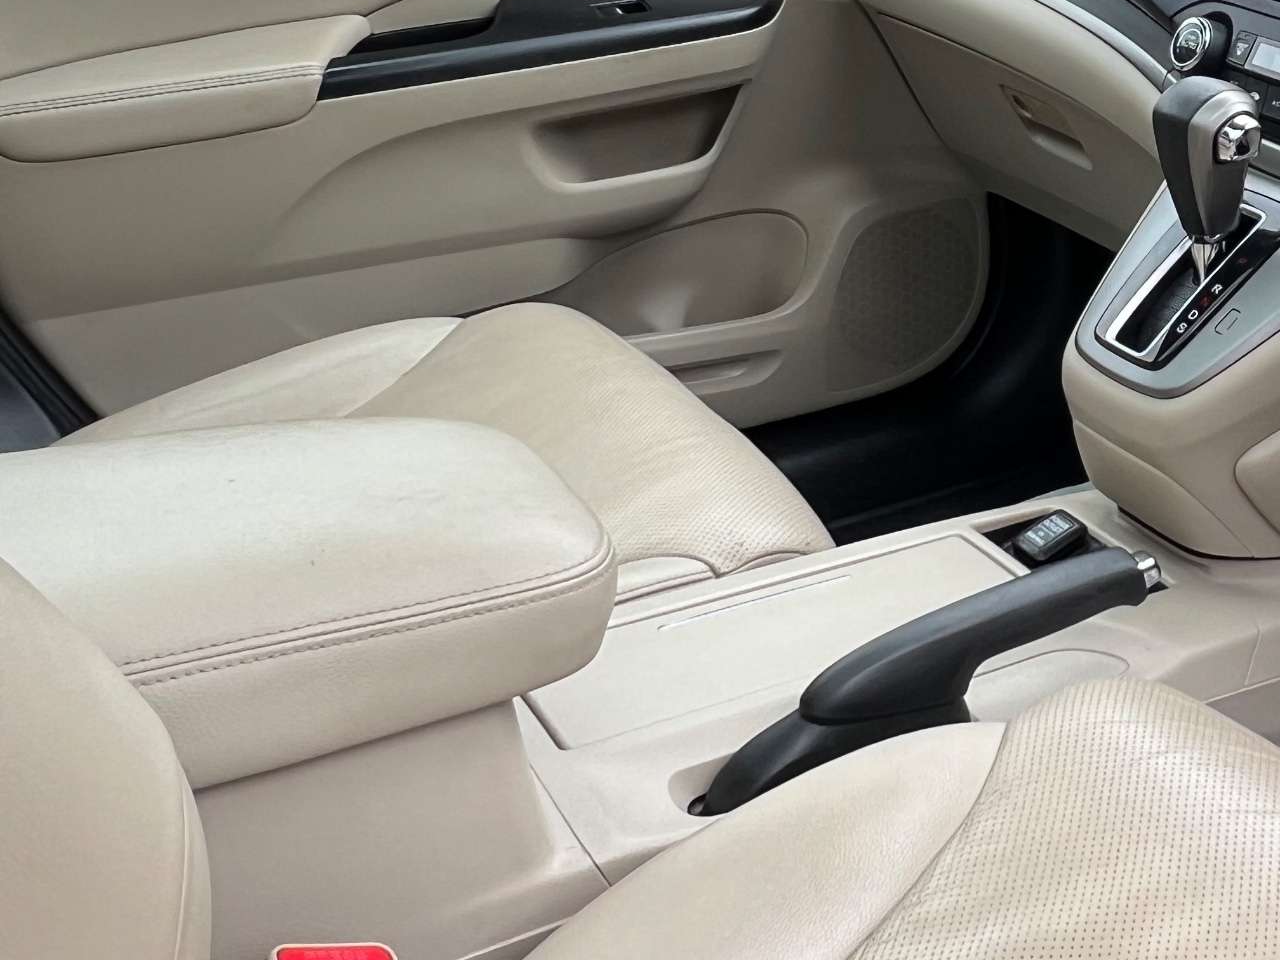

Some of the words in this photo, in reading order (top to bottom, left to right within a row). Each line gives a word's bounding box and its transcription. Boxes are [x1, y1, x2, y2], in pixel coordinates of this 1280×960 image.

[1211, 284, 1223, 295] R
[1187, 309, 1199, 320] D
[1176, 322, 1188, 333] S
